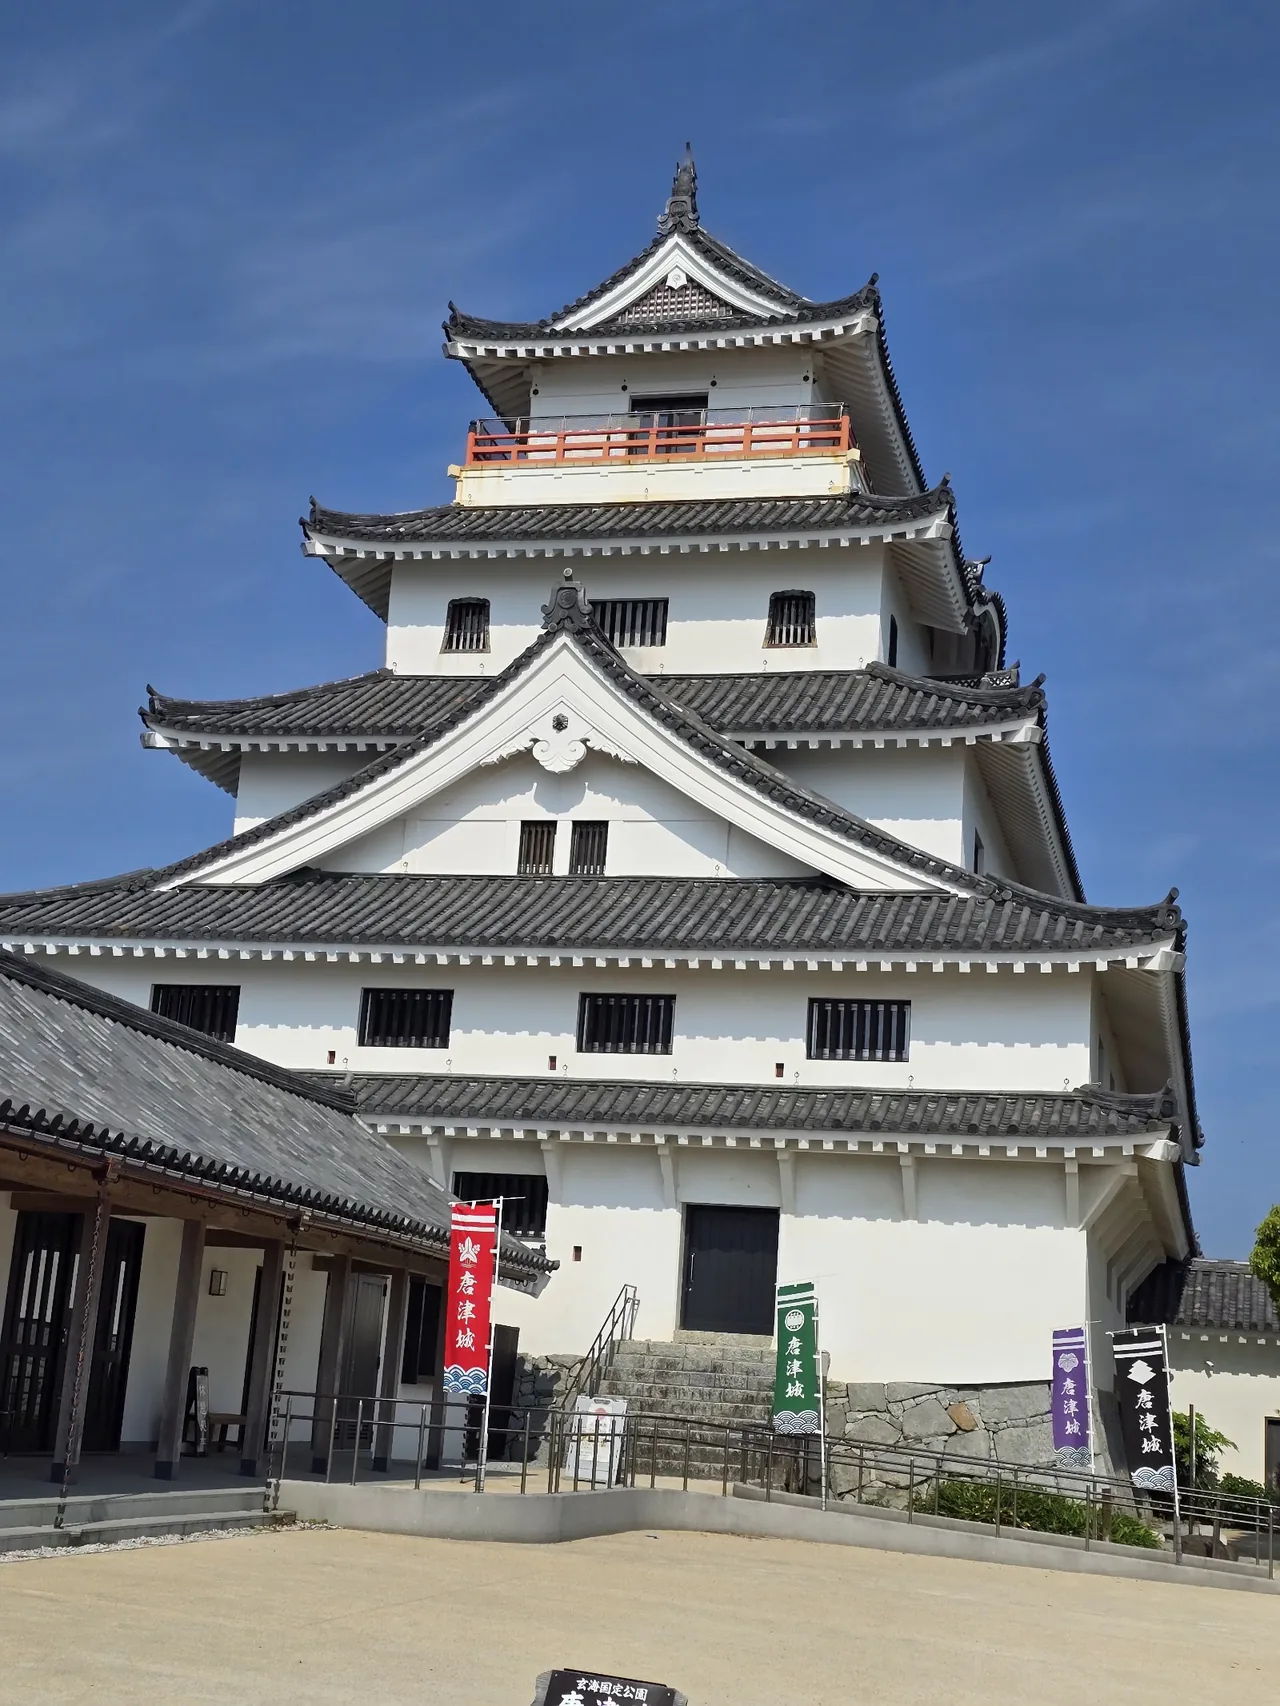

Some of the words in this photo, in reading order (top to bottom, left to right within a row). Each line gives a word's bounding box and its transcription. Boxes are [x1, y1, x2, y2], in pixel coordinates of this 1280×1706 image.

[456, 1270, 478, 1352] 唐津城
[785, 1336, 805, 1399] 唐津城
[1061, 1377, 1082, 1436] 唐津城
[1135, 1388, 1163, 1454] 唐津城
[576, 1677, 648, 1702] 玄海国定公園
